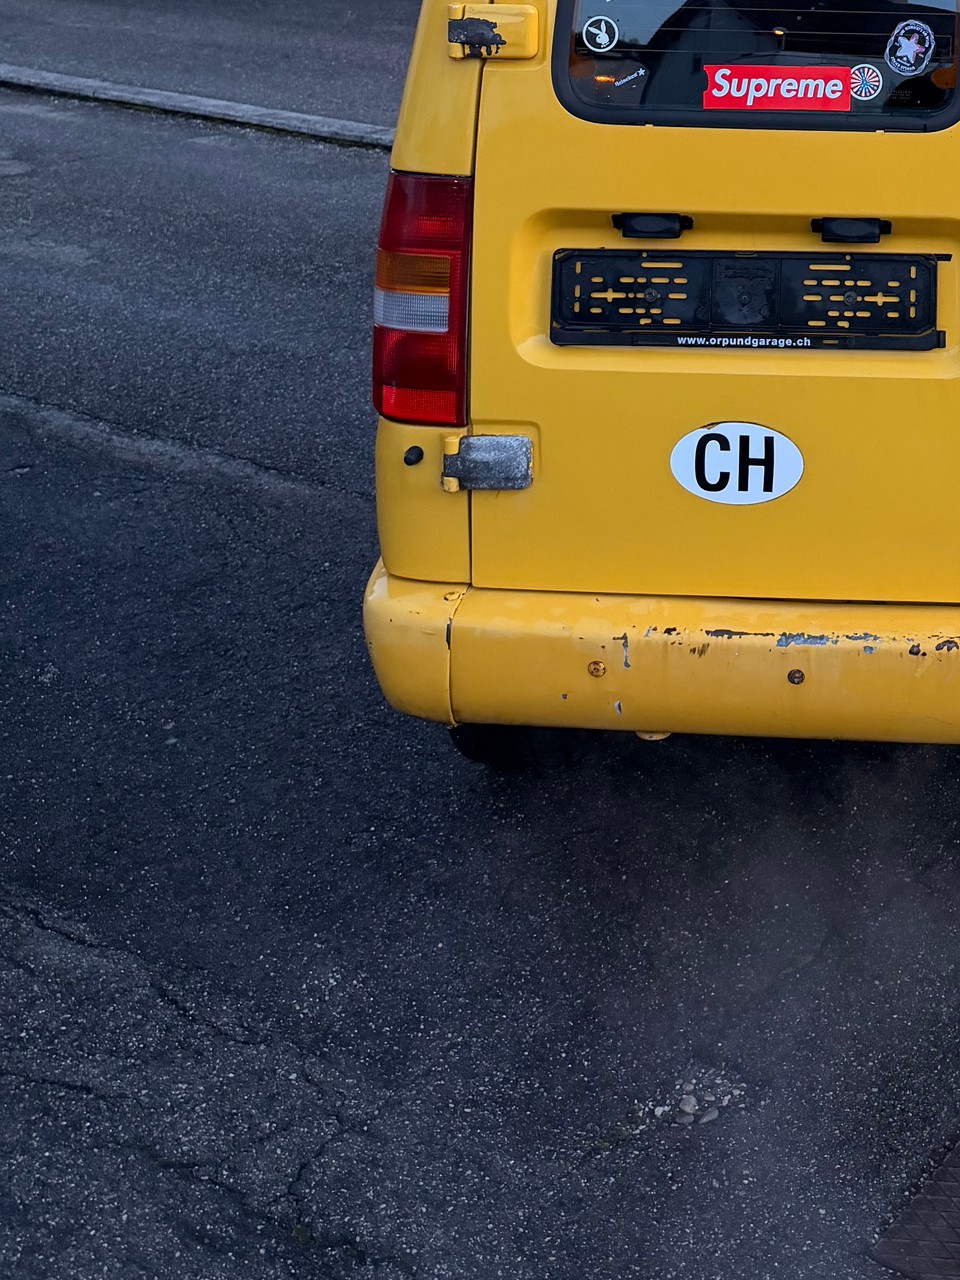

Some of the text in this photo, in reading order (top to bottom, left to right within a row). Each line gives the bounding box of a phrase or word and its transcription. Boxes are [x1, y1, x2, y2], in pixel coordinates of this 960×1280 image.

[711, 68, 844, 107] Supreme
[677, 335, 811, 349] www.orpundgarage.ch
[694, 432, 775, 494] CH
